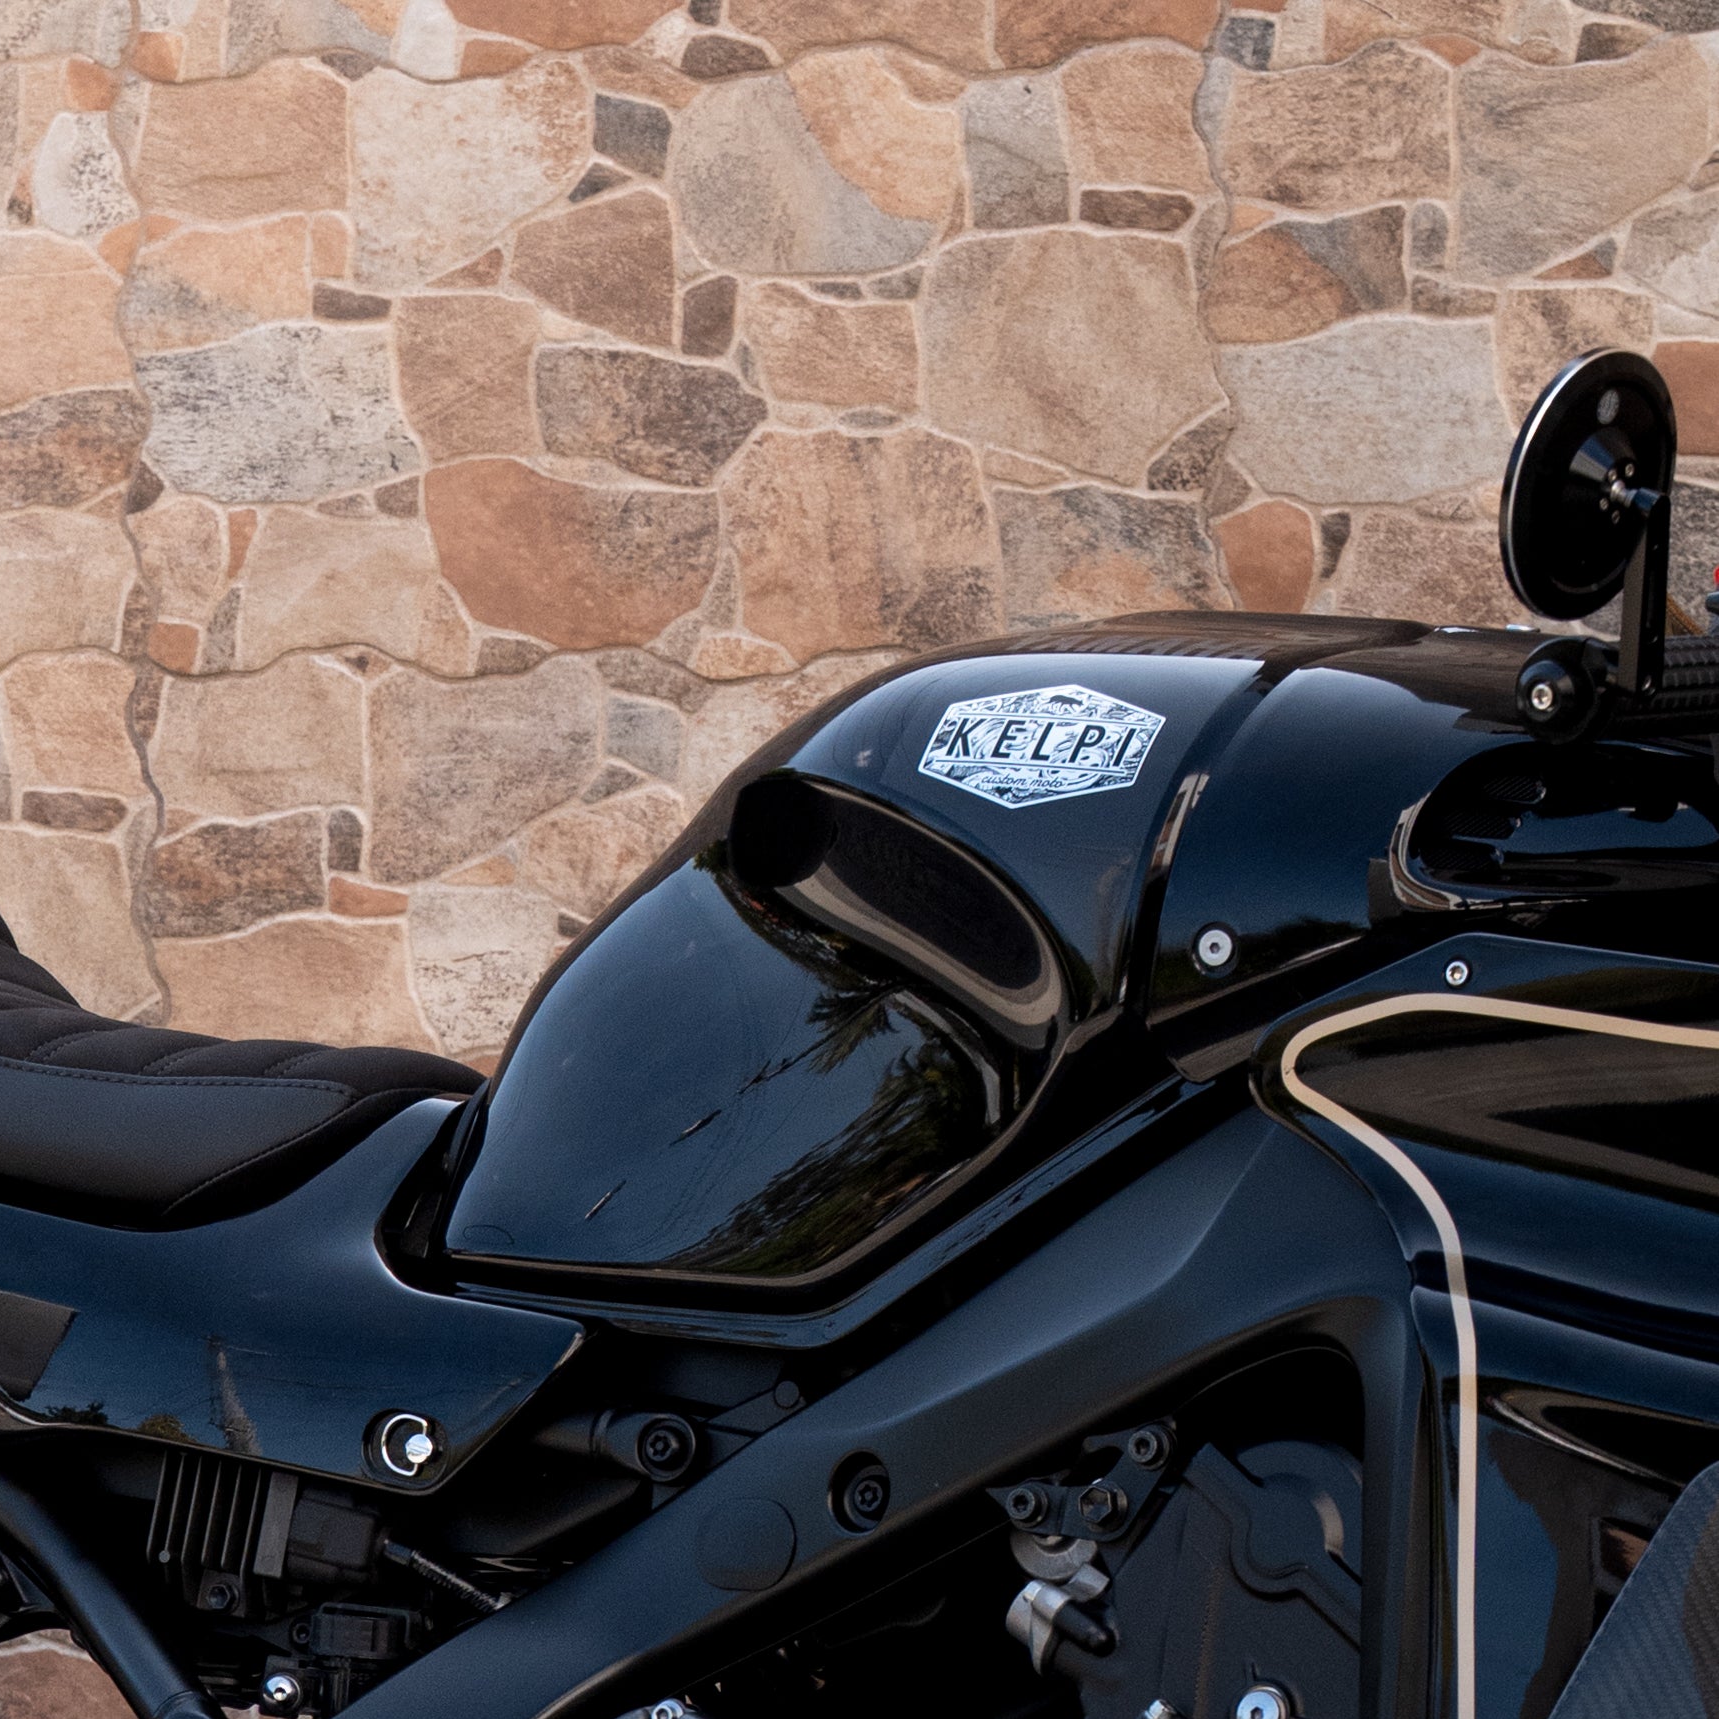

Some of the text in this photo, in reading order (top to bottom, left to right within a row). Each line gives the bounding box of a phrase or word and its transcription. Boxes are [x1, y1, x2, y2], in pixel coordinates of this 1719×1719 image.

[945, 718, 1137, 768] KELPI
[981, 773, 1064, 788] custom moto
